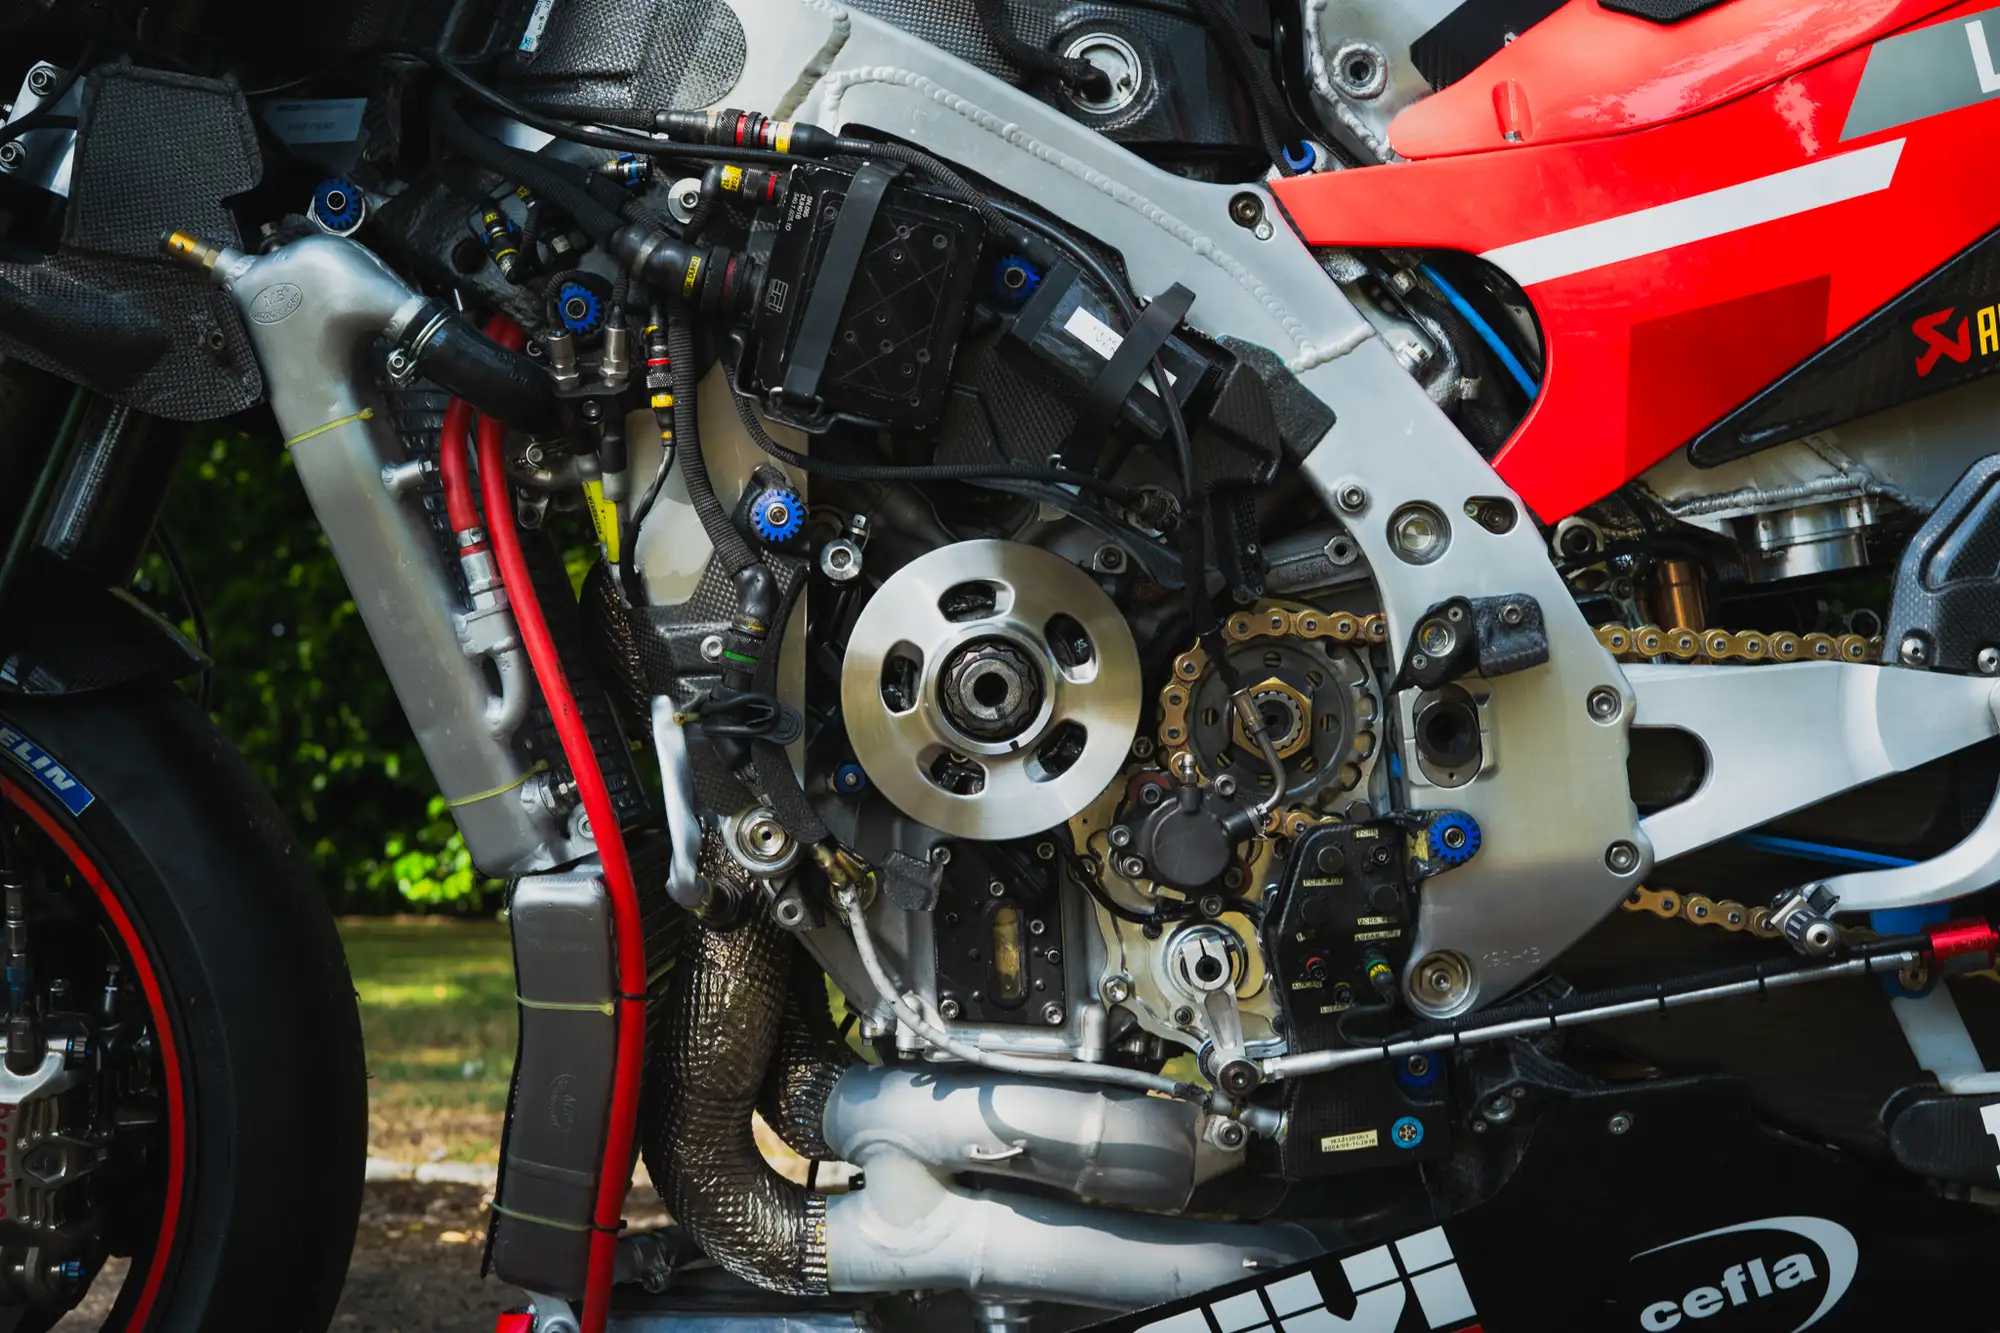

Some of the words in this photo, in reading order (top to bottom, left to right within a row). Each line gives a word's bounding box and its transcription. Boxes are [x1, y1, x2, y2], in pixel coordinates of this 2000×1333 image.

[1977, 303, 2000, 356] A
[0, 727, 76, 791] ELIN
[1640, 1253, 1818, 1333] cefla
